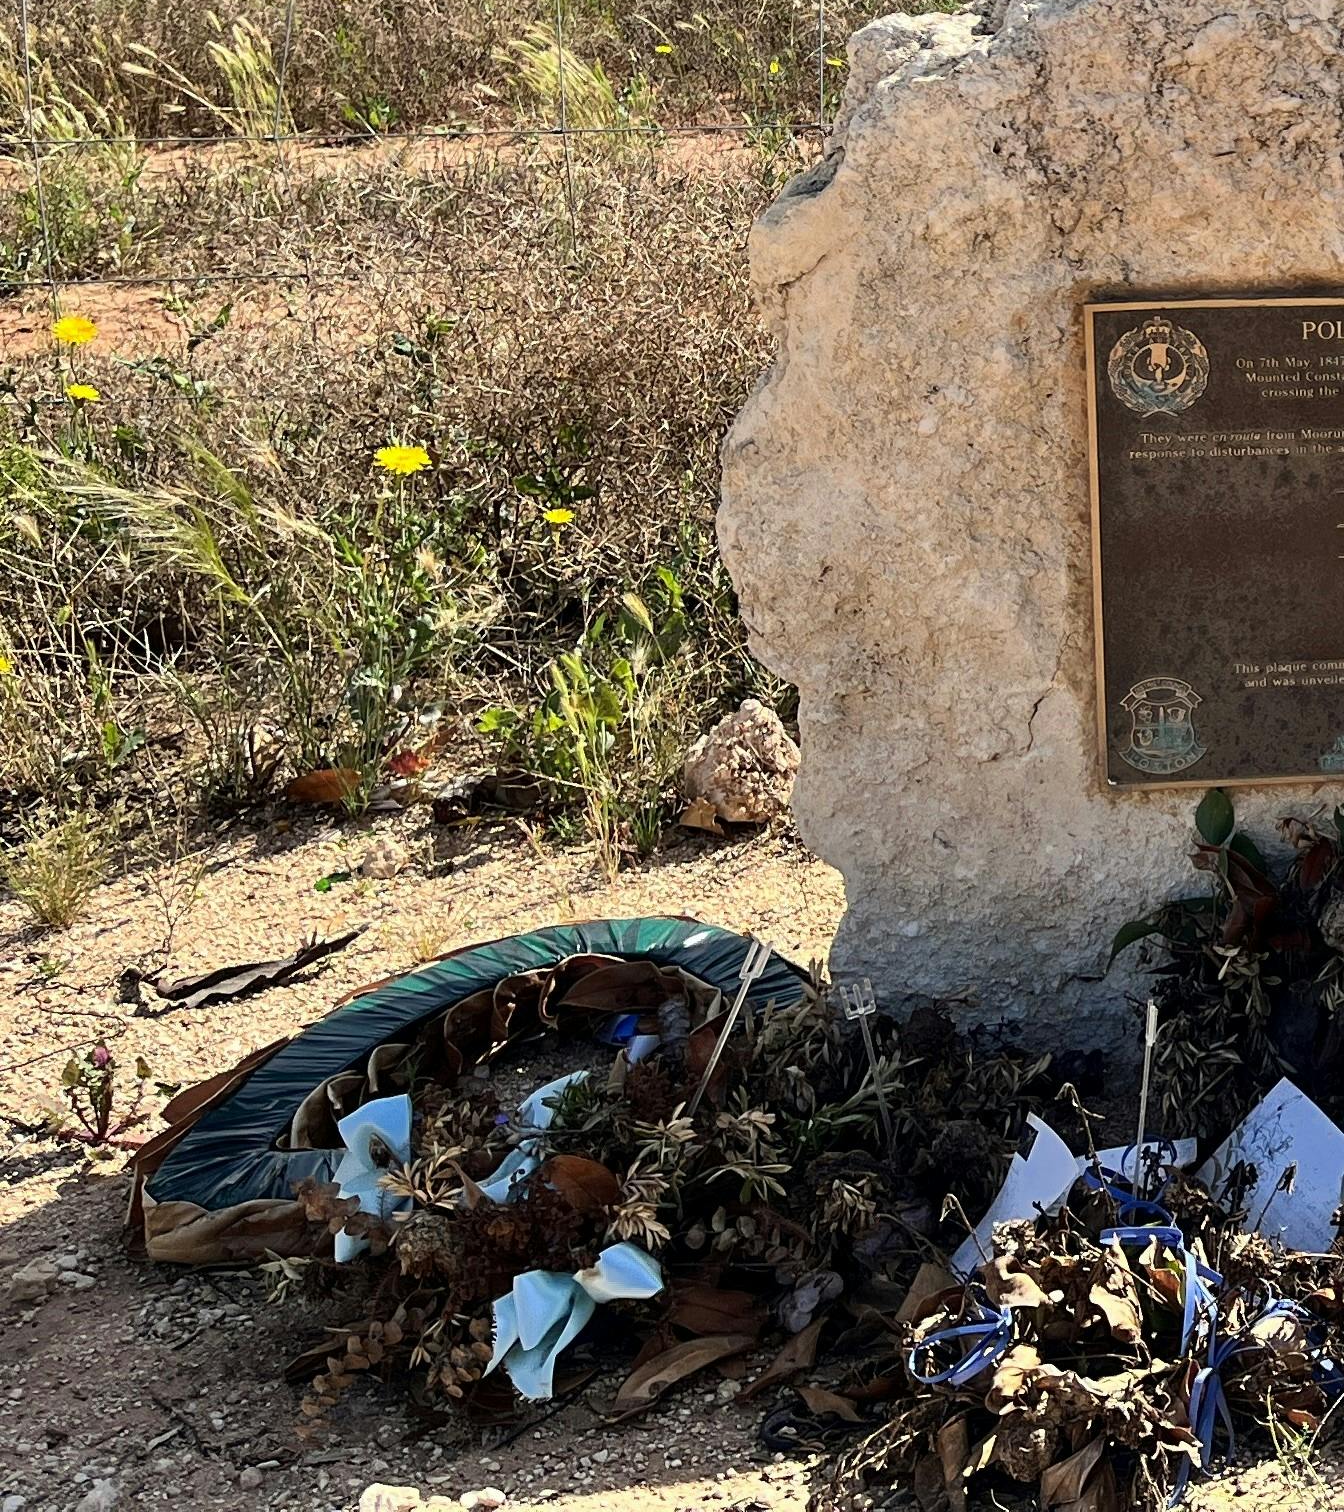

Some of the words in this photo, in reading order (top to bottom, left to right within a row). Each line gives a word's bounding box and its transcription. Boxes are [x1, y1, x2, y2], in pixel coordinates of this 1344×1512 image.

[1236, 357, 1254, 369] On
[1260, 357, 1279, 368] 7th
[1246, 372, 1301, 383] Mounted
[1261, 388, 1314, 399] crossing
[1319, 386, 1339, 396] the
[1140, 432, 1171, 445] They
[1177, 433, 1207, 442] were
[1267, 430, 1295, 440] from
[1129, 449, 1186, 461] response
[1191, 448, 1204, 457] to
[1209, 445, 1290, 458] disturbances
[1296, 445, 1307, 455] in
[1312, 443, 1332, 453] the
[1233, 663, 1260, 675] This
[1265, 662, 1307, 675] plaque
[1244, 677, 1267, 688] and
[1272, 677, 1296, 687] was
